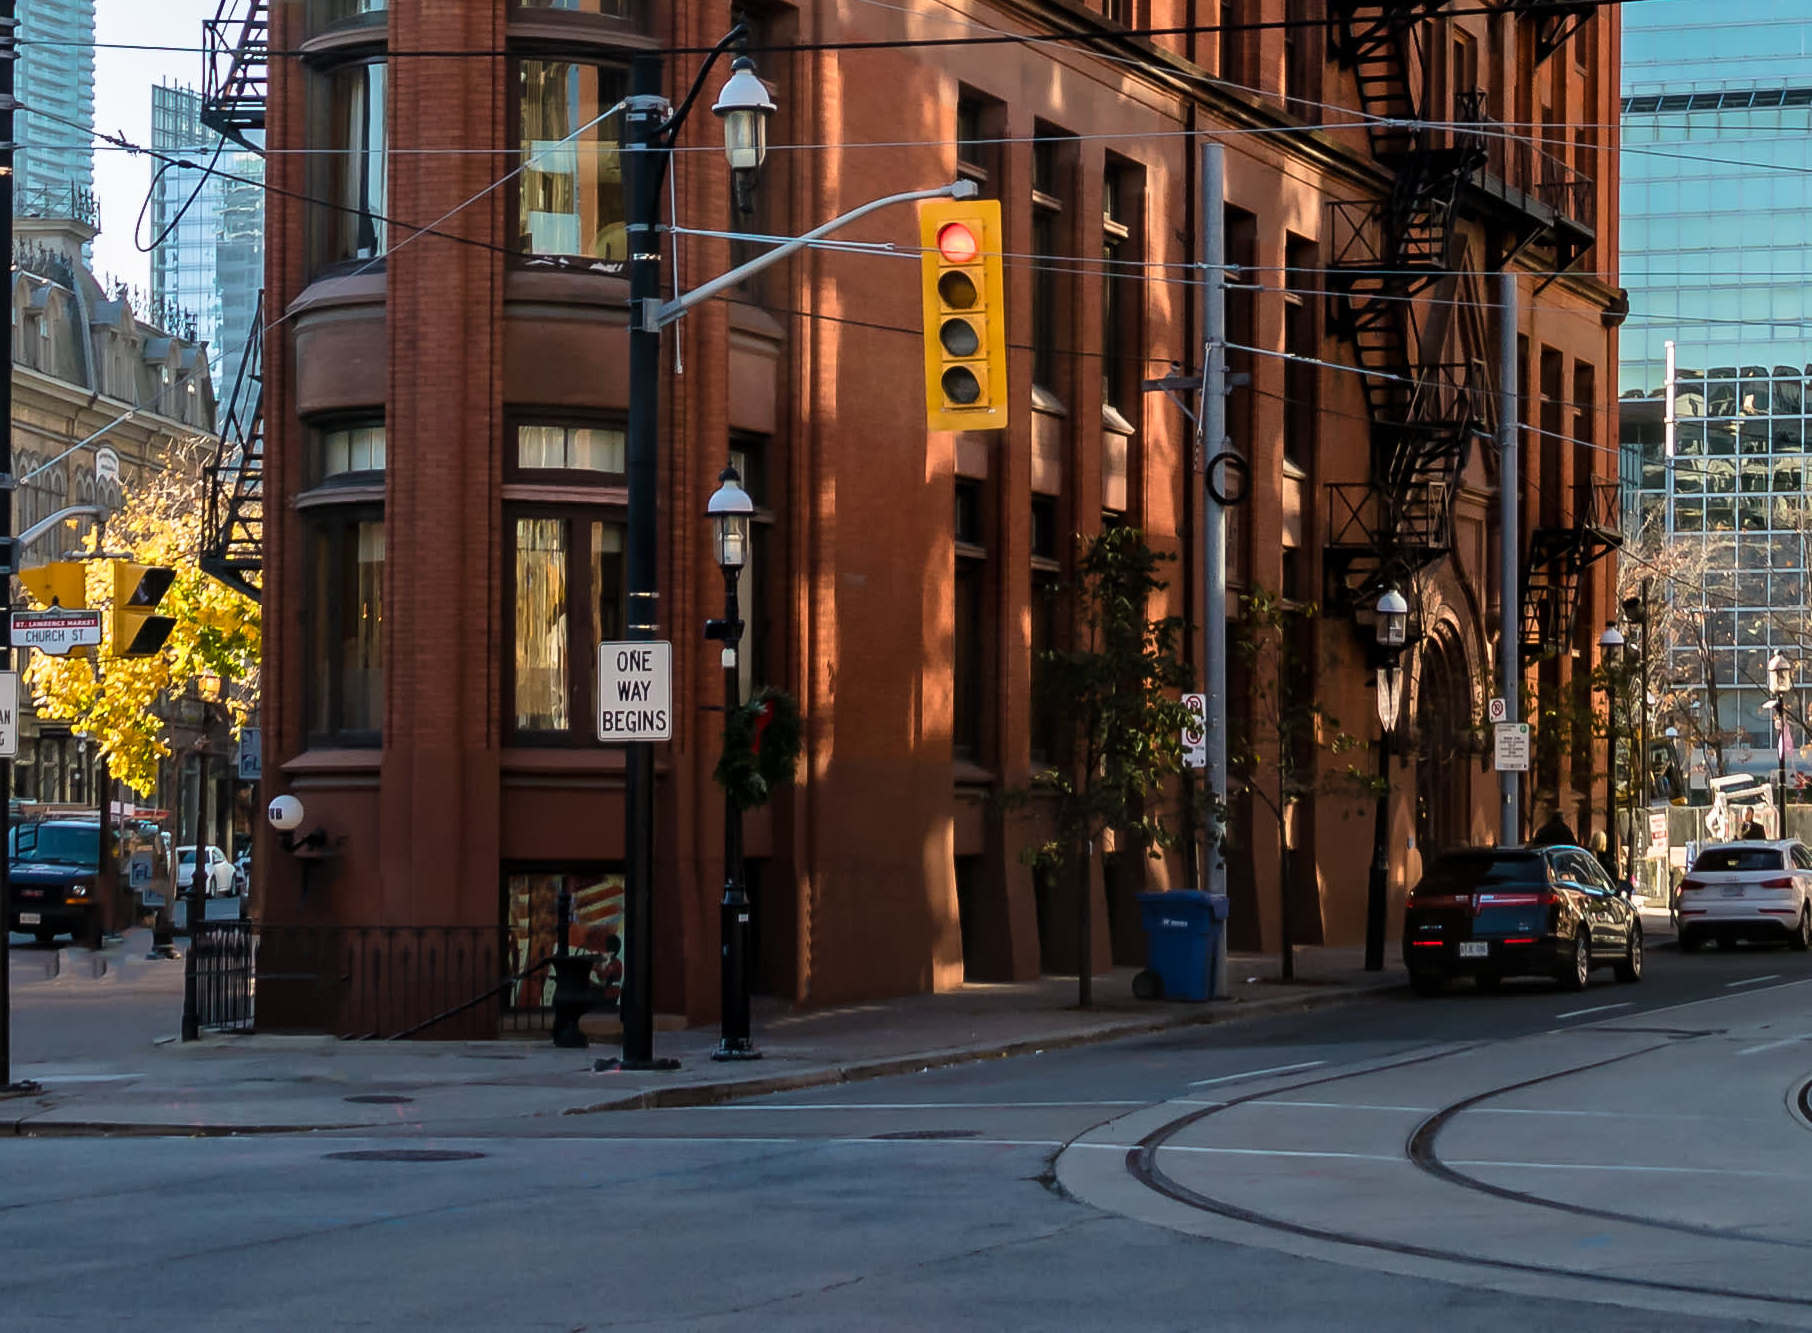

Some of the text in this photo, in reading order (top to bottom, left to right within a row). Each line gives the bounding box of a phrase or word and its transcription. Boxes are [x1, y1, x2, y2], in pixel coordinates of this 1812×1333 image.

[67, 619, 95, 627] MARKET
[25, 629, 84, 642] CHURCH ST
[616, 650, 653, 672] ONE
[617, 680, 651, 702] WAY
[602, 710, 667, 732] BEGINS
